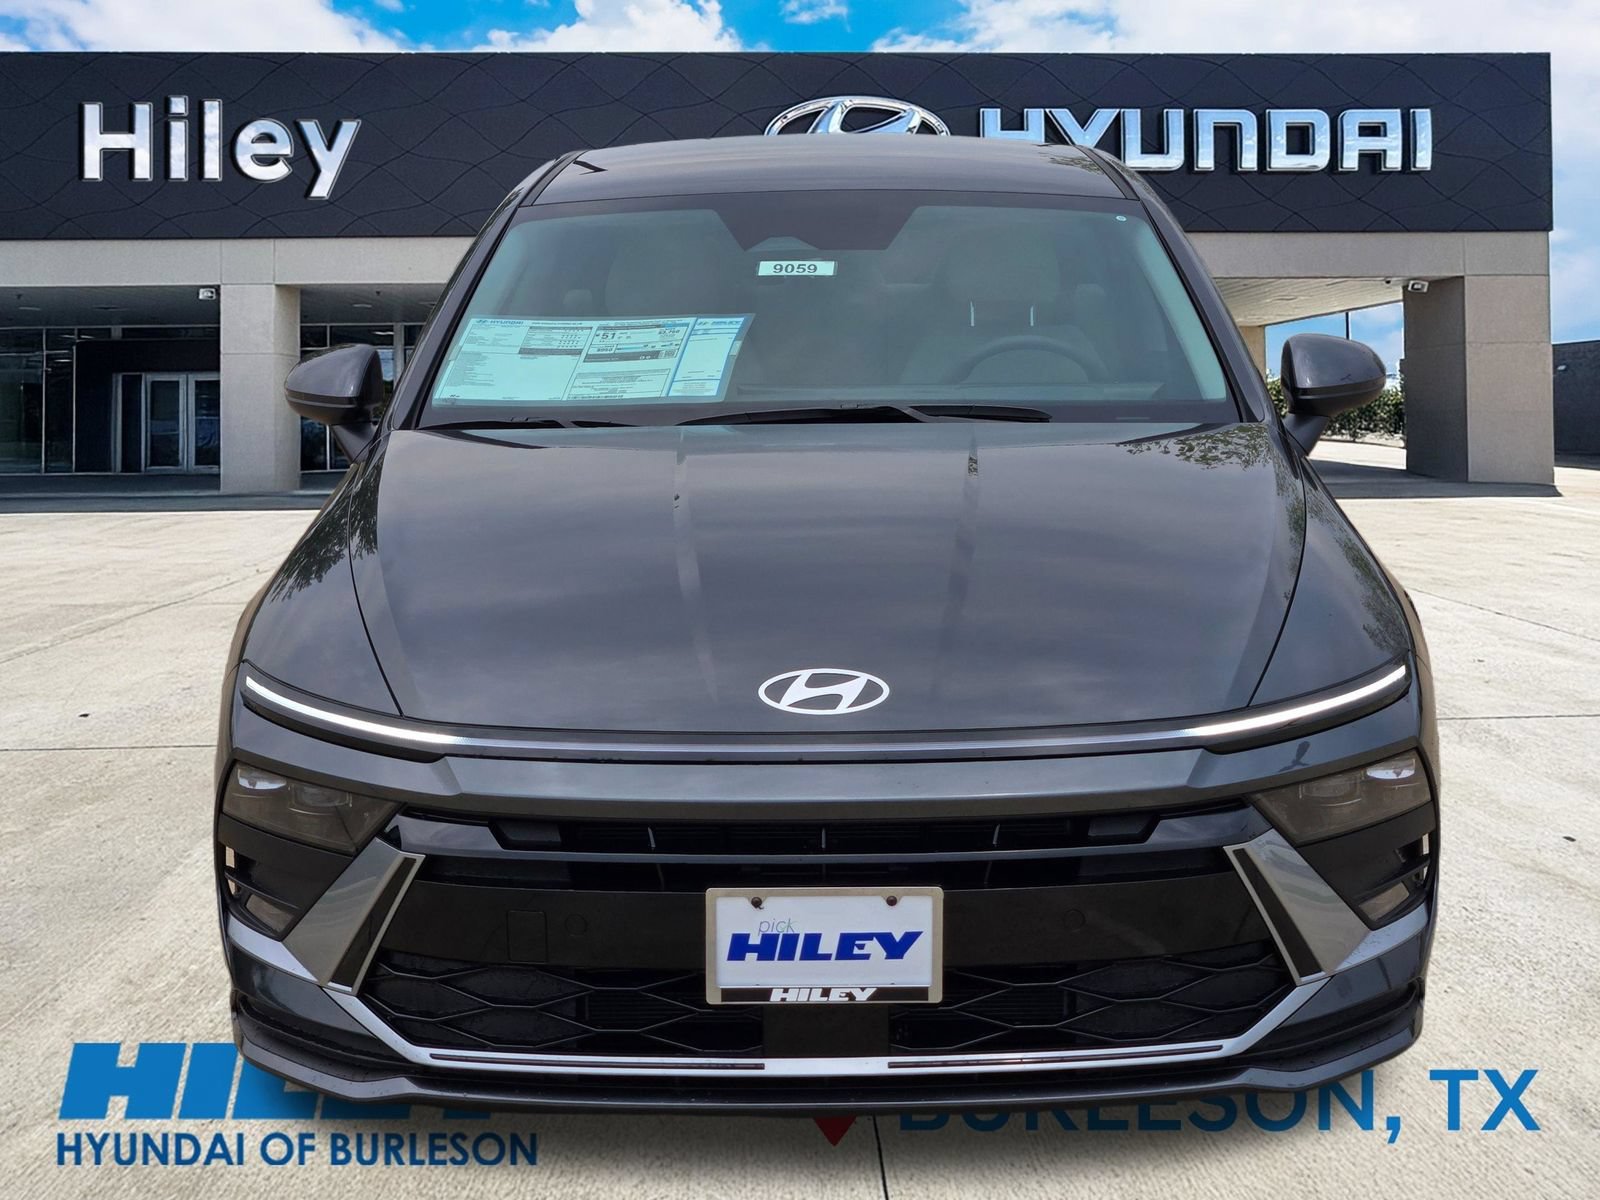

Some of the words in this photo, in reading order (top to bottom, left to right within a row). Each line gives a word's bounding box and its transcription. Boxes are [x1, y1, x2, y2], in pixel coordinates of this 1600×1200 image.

[79, 95, 362, 200] Hiley
[979, 107, 1433, 172] HYUNDAI
[772, 263, 818, 274] 9059
[601, 332, 616, 340] 51
[757, 918, 797, 936] pick
[726, 930, 924, 962] HILEY
[769, 987, 878, 1002] HILEY
